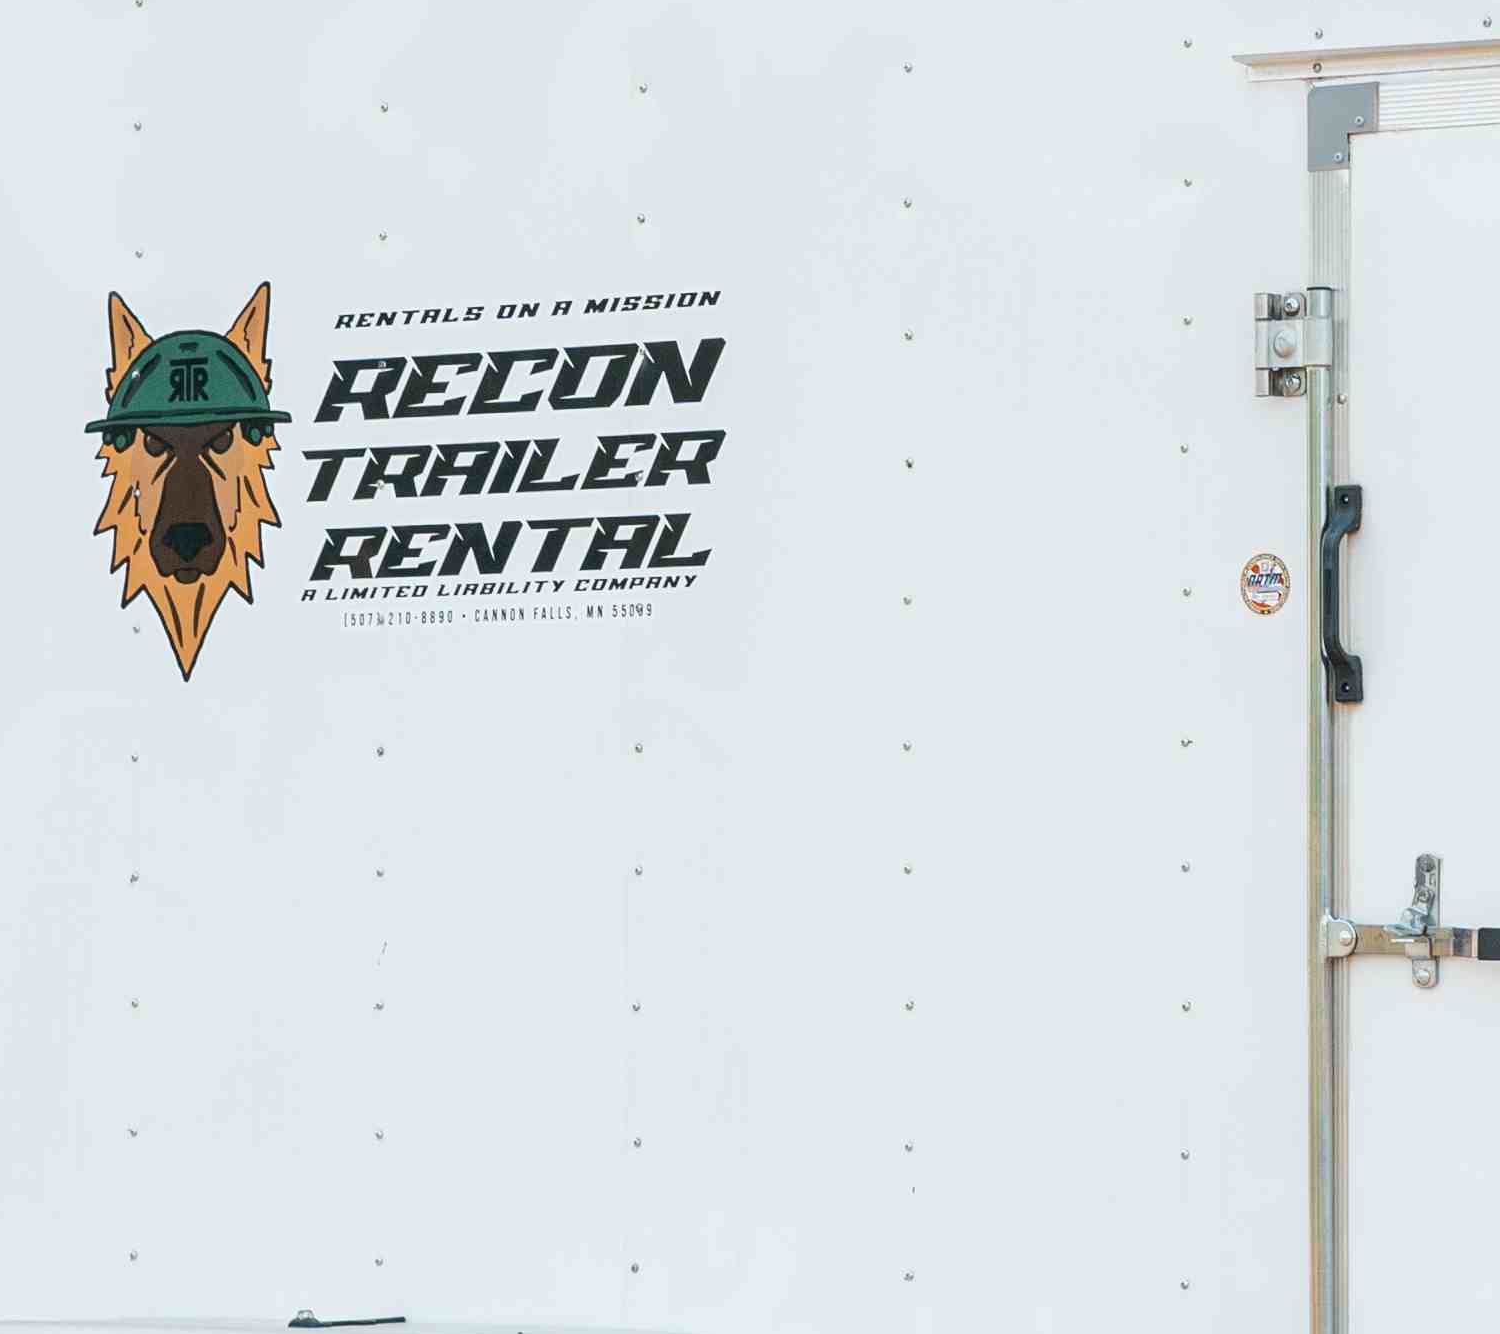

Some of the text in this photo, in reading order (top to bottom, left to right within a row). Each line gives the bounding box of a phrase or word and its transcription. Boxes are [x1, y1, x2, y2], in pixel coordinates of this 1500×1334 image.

[334, 290, 721, 330] RENTALS ON A MISSION
[313, 337, 727, 424] RECON
[301, 429, 727, 503] TRAILER
[309, 512, 712, 582] RENTAL
[301, 575, 697, 602] A LIMITED LIABILITY COMPANY
[474, 608, 525, 623] CANNON
[586, 605, 604, 619] MN
